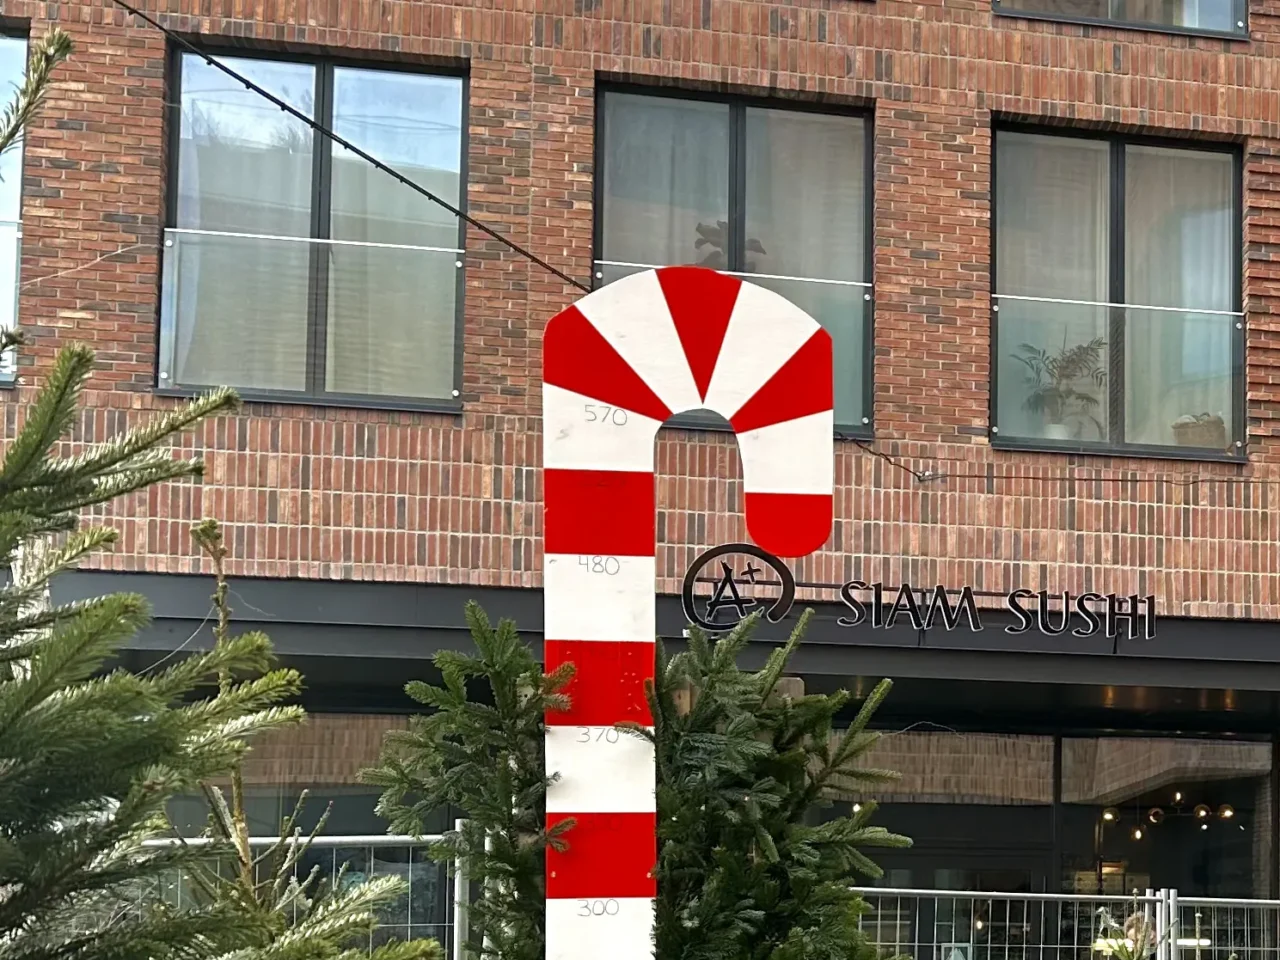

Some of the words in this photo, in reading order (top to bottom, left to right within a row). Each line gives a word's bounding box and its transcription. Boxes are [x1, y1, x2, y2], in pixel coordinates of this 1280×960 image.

[584, 404, 628, 427] 570
[577, 554, 621, 576] 480
[836, 579, 984, 632] SIAM
[1005, 588, 1157, 640] SUSHI
[576, 726, 620, 744] 370
[576, 898, 620, 917] 300
